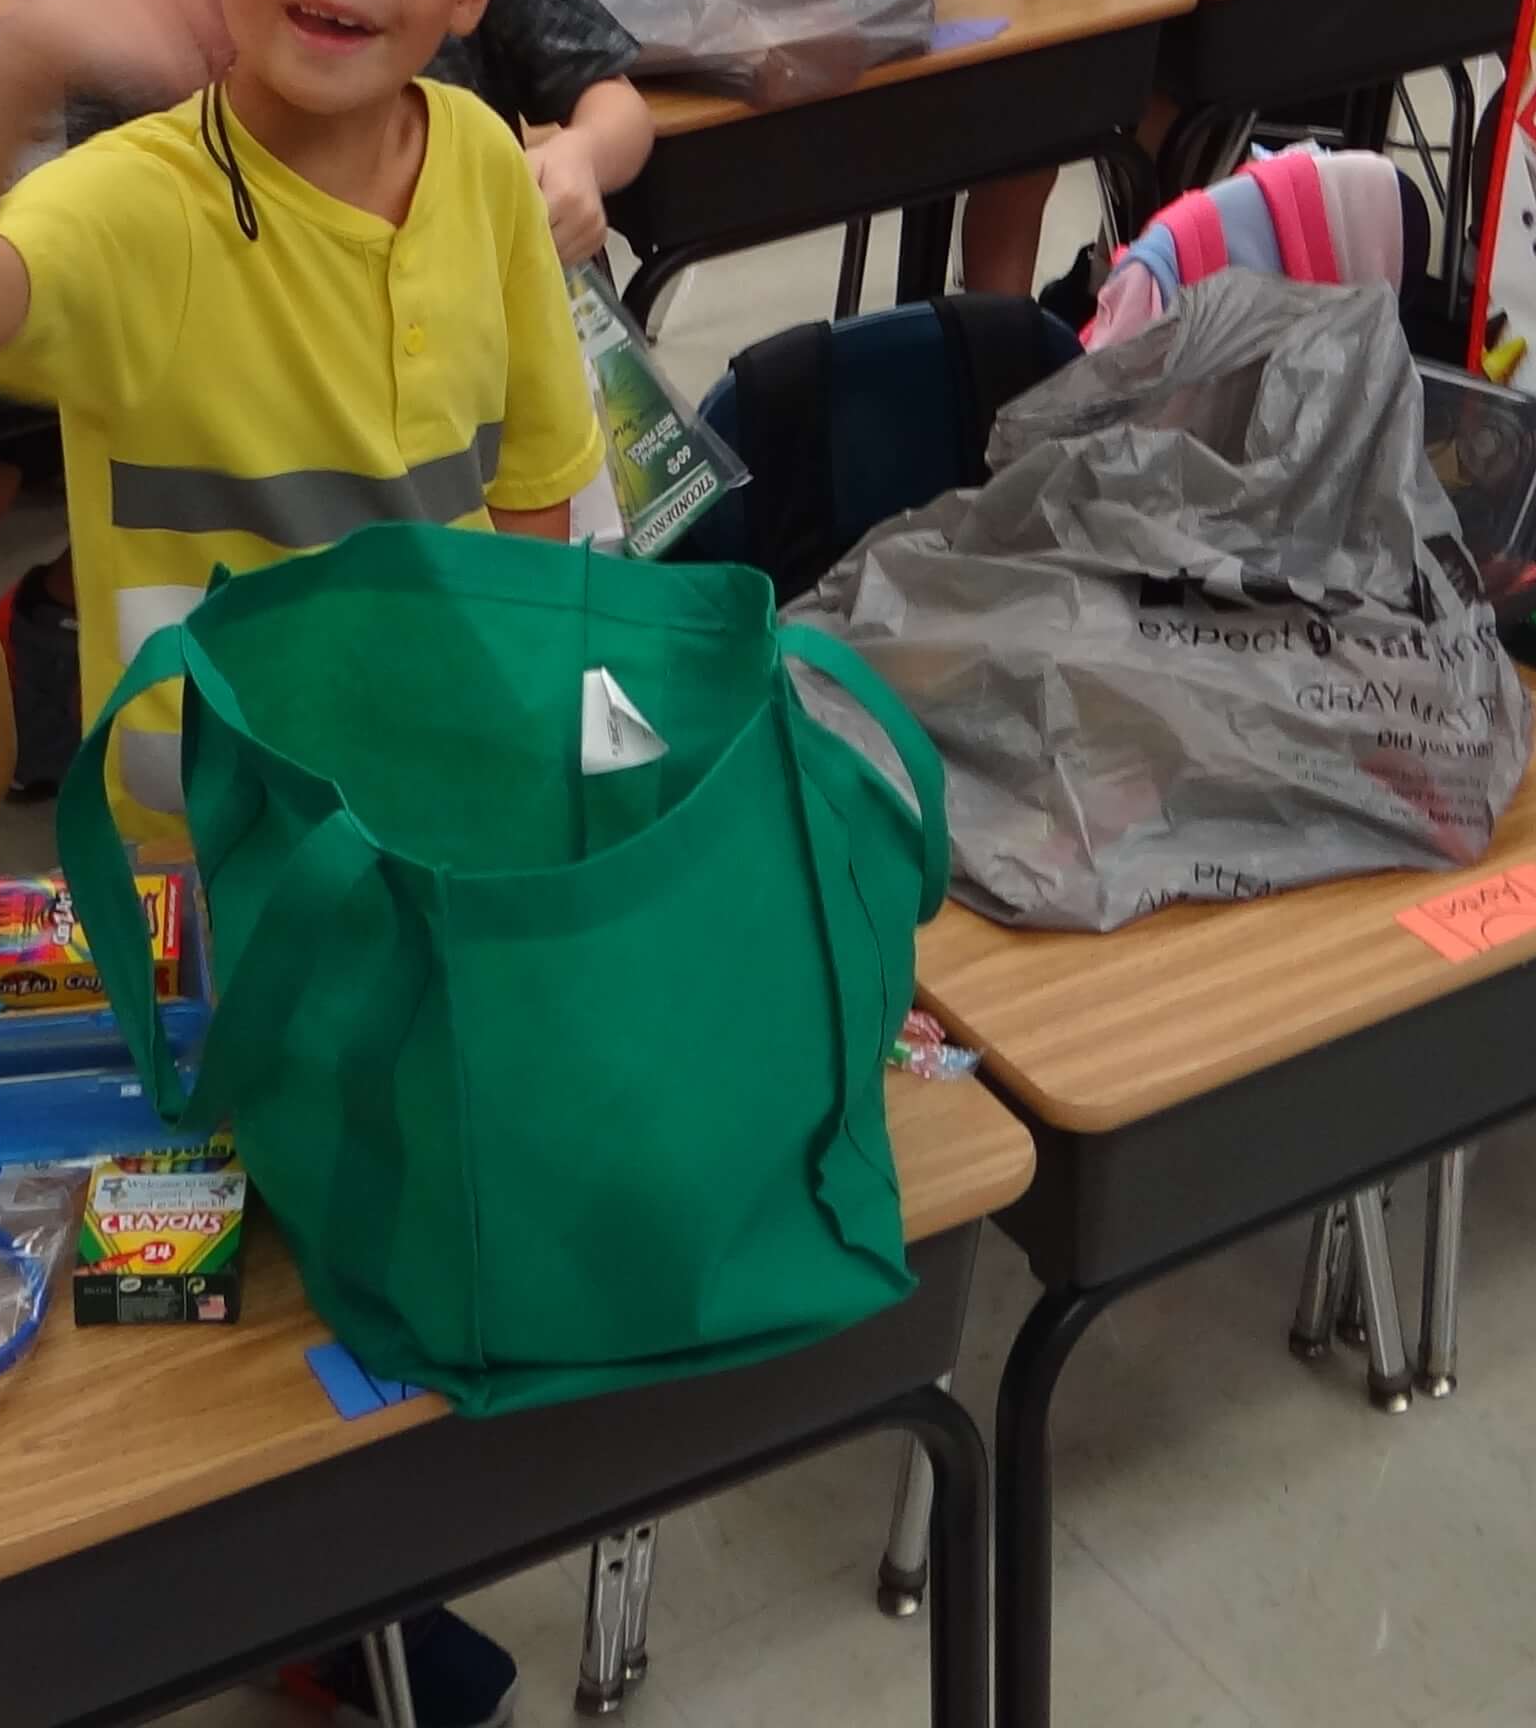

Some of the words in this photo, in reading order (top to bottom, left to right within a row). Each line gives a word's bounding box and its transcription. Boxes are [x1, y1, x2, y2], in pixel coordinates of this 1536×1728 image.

[630, 472, 715, 554] TICONDEROGA
[1137, 617, 1293, 656] expect
[1376, 728, 1413, 751] Did
[100, 1210, 224, 1235] CRAYONS
[143, 1244, 172, 1261] 24
